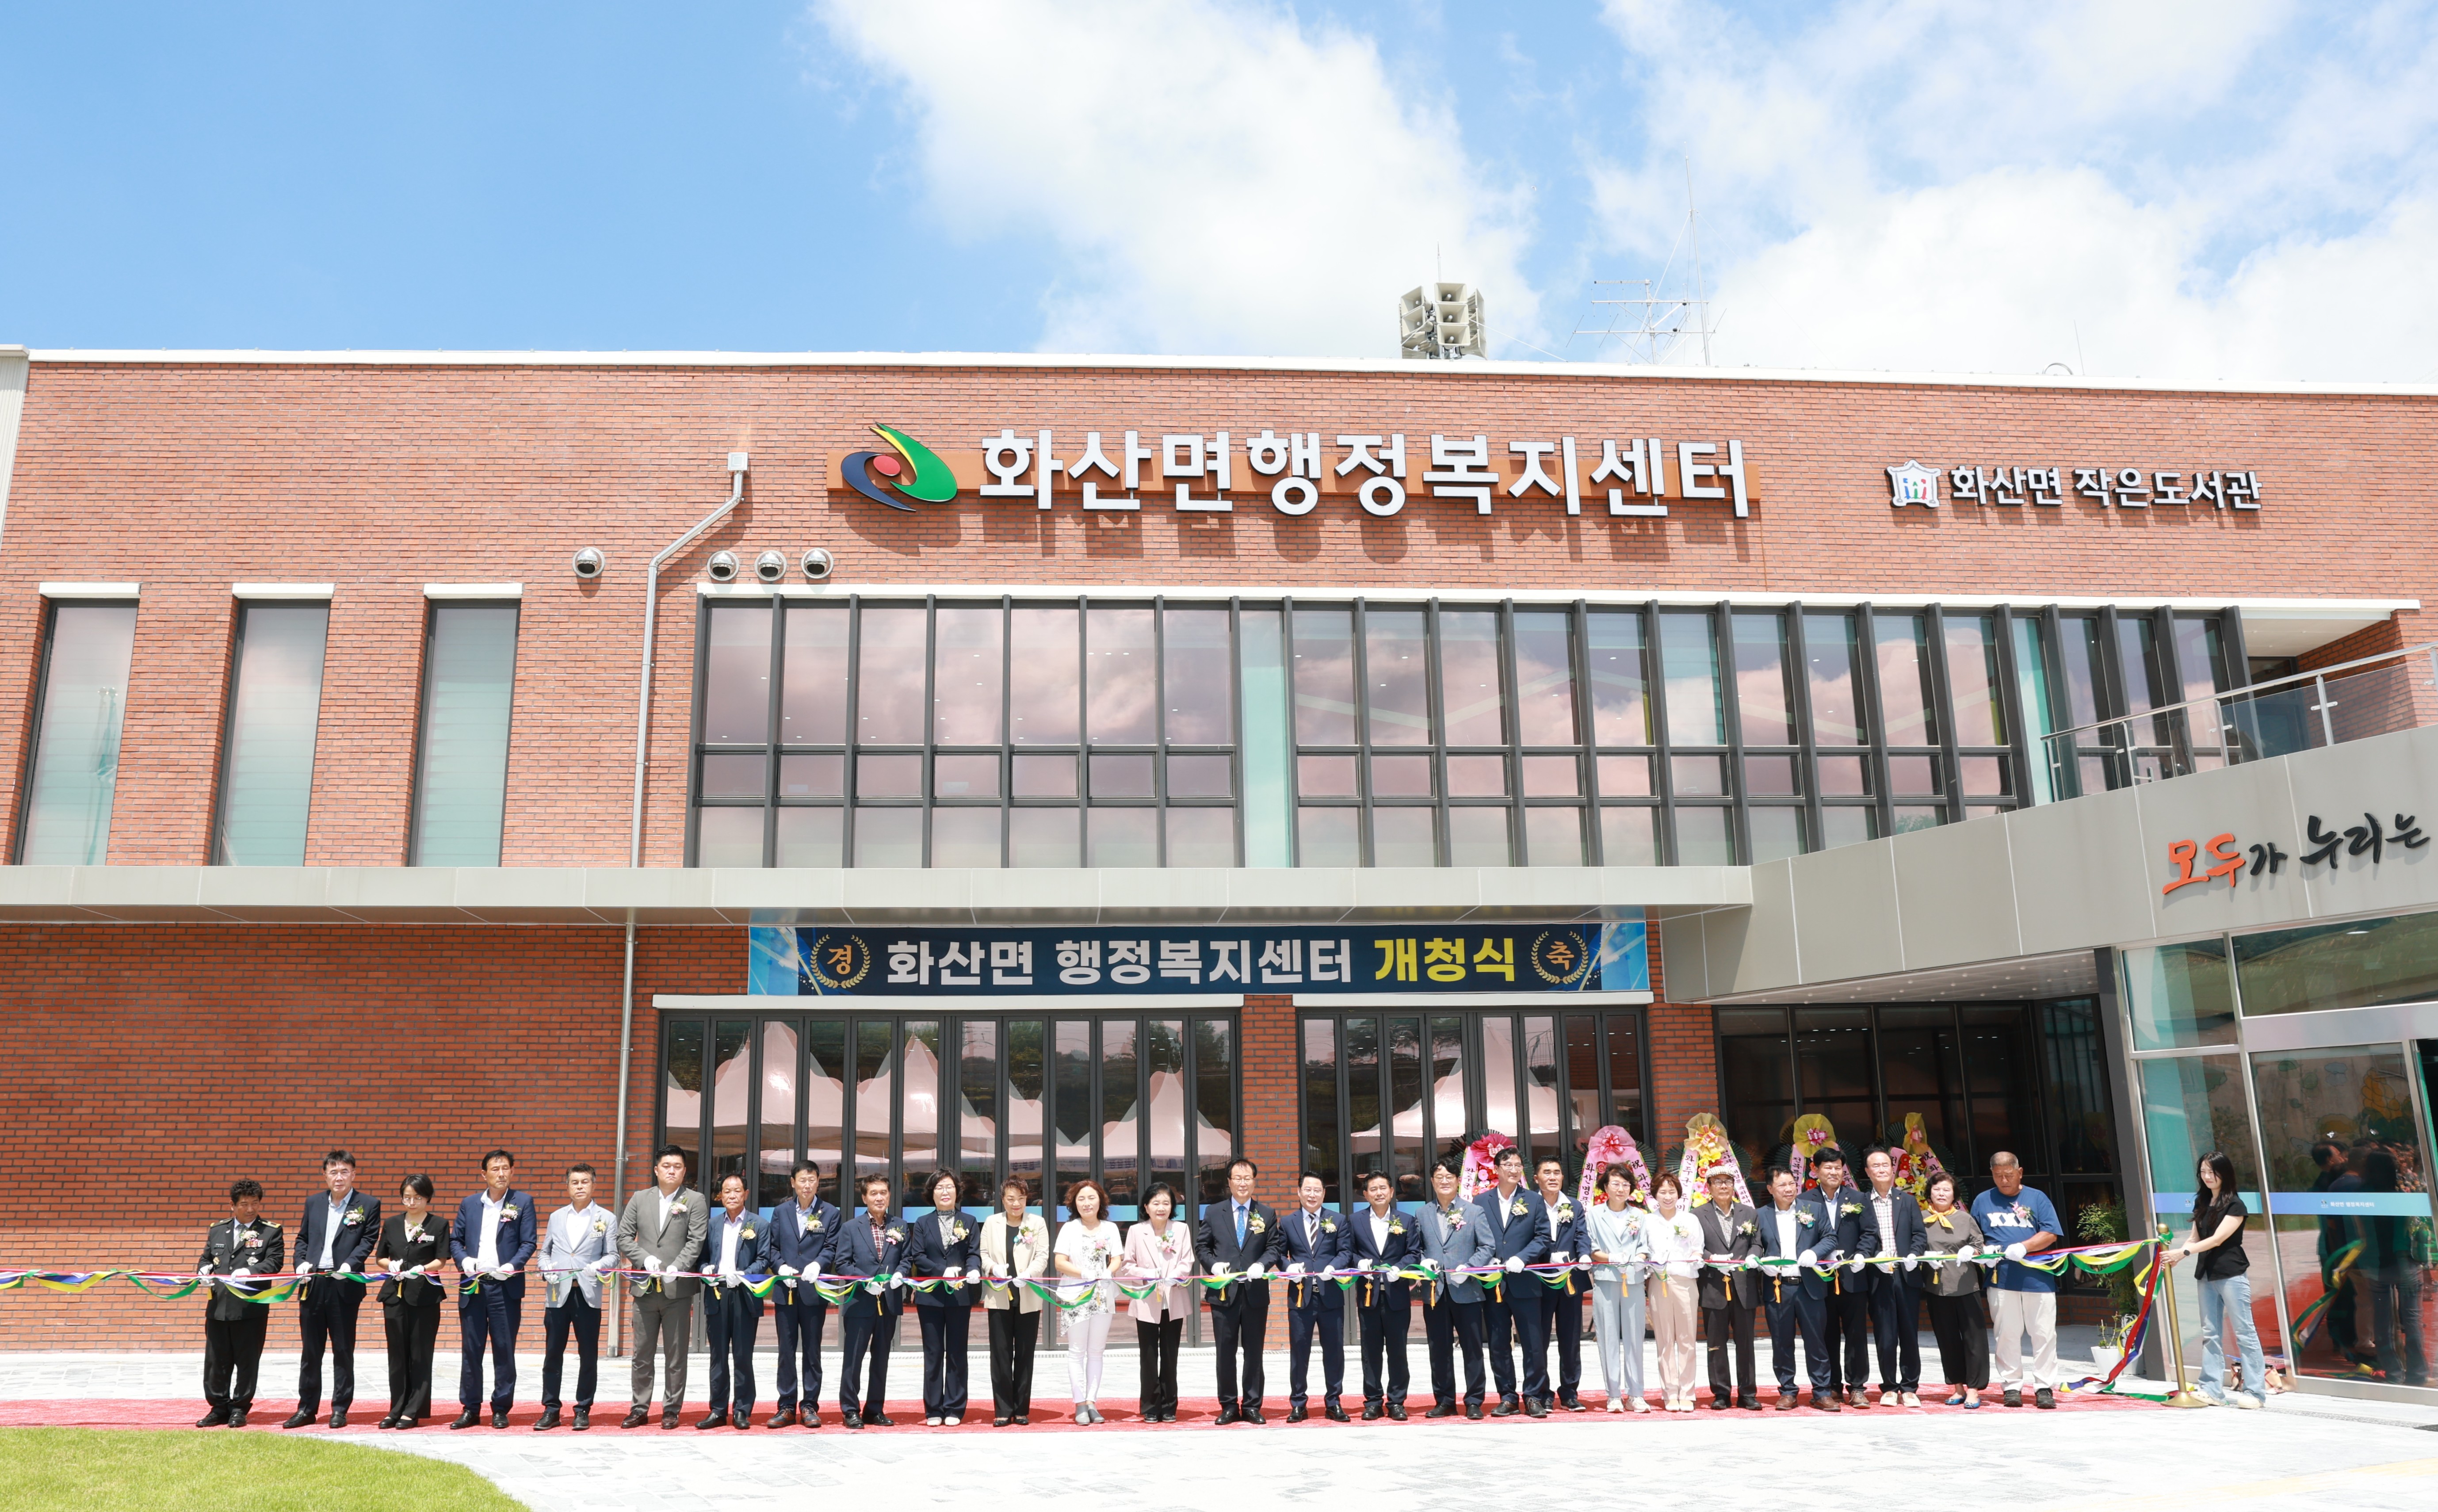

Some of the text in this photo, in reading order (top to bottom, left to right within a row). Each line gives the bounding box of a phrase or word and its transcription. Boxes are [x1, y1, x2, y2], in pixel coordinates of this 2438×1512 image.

[979, 428, 1749, 517] 화산면행정복지센터
[1950, 466, 2263, 509] 화산면 작은도서관
[2162, 813, 2430, 895] 모두가 누리는
[827, 944, 852, 975] 경
[887, 938, 1515, 985] 화산면 행정복지센터 개청식
[1546, 941, 1574, 970] 축
[1792, 1157, 1803, 1193] 전북특별
